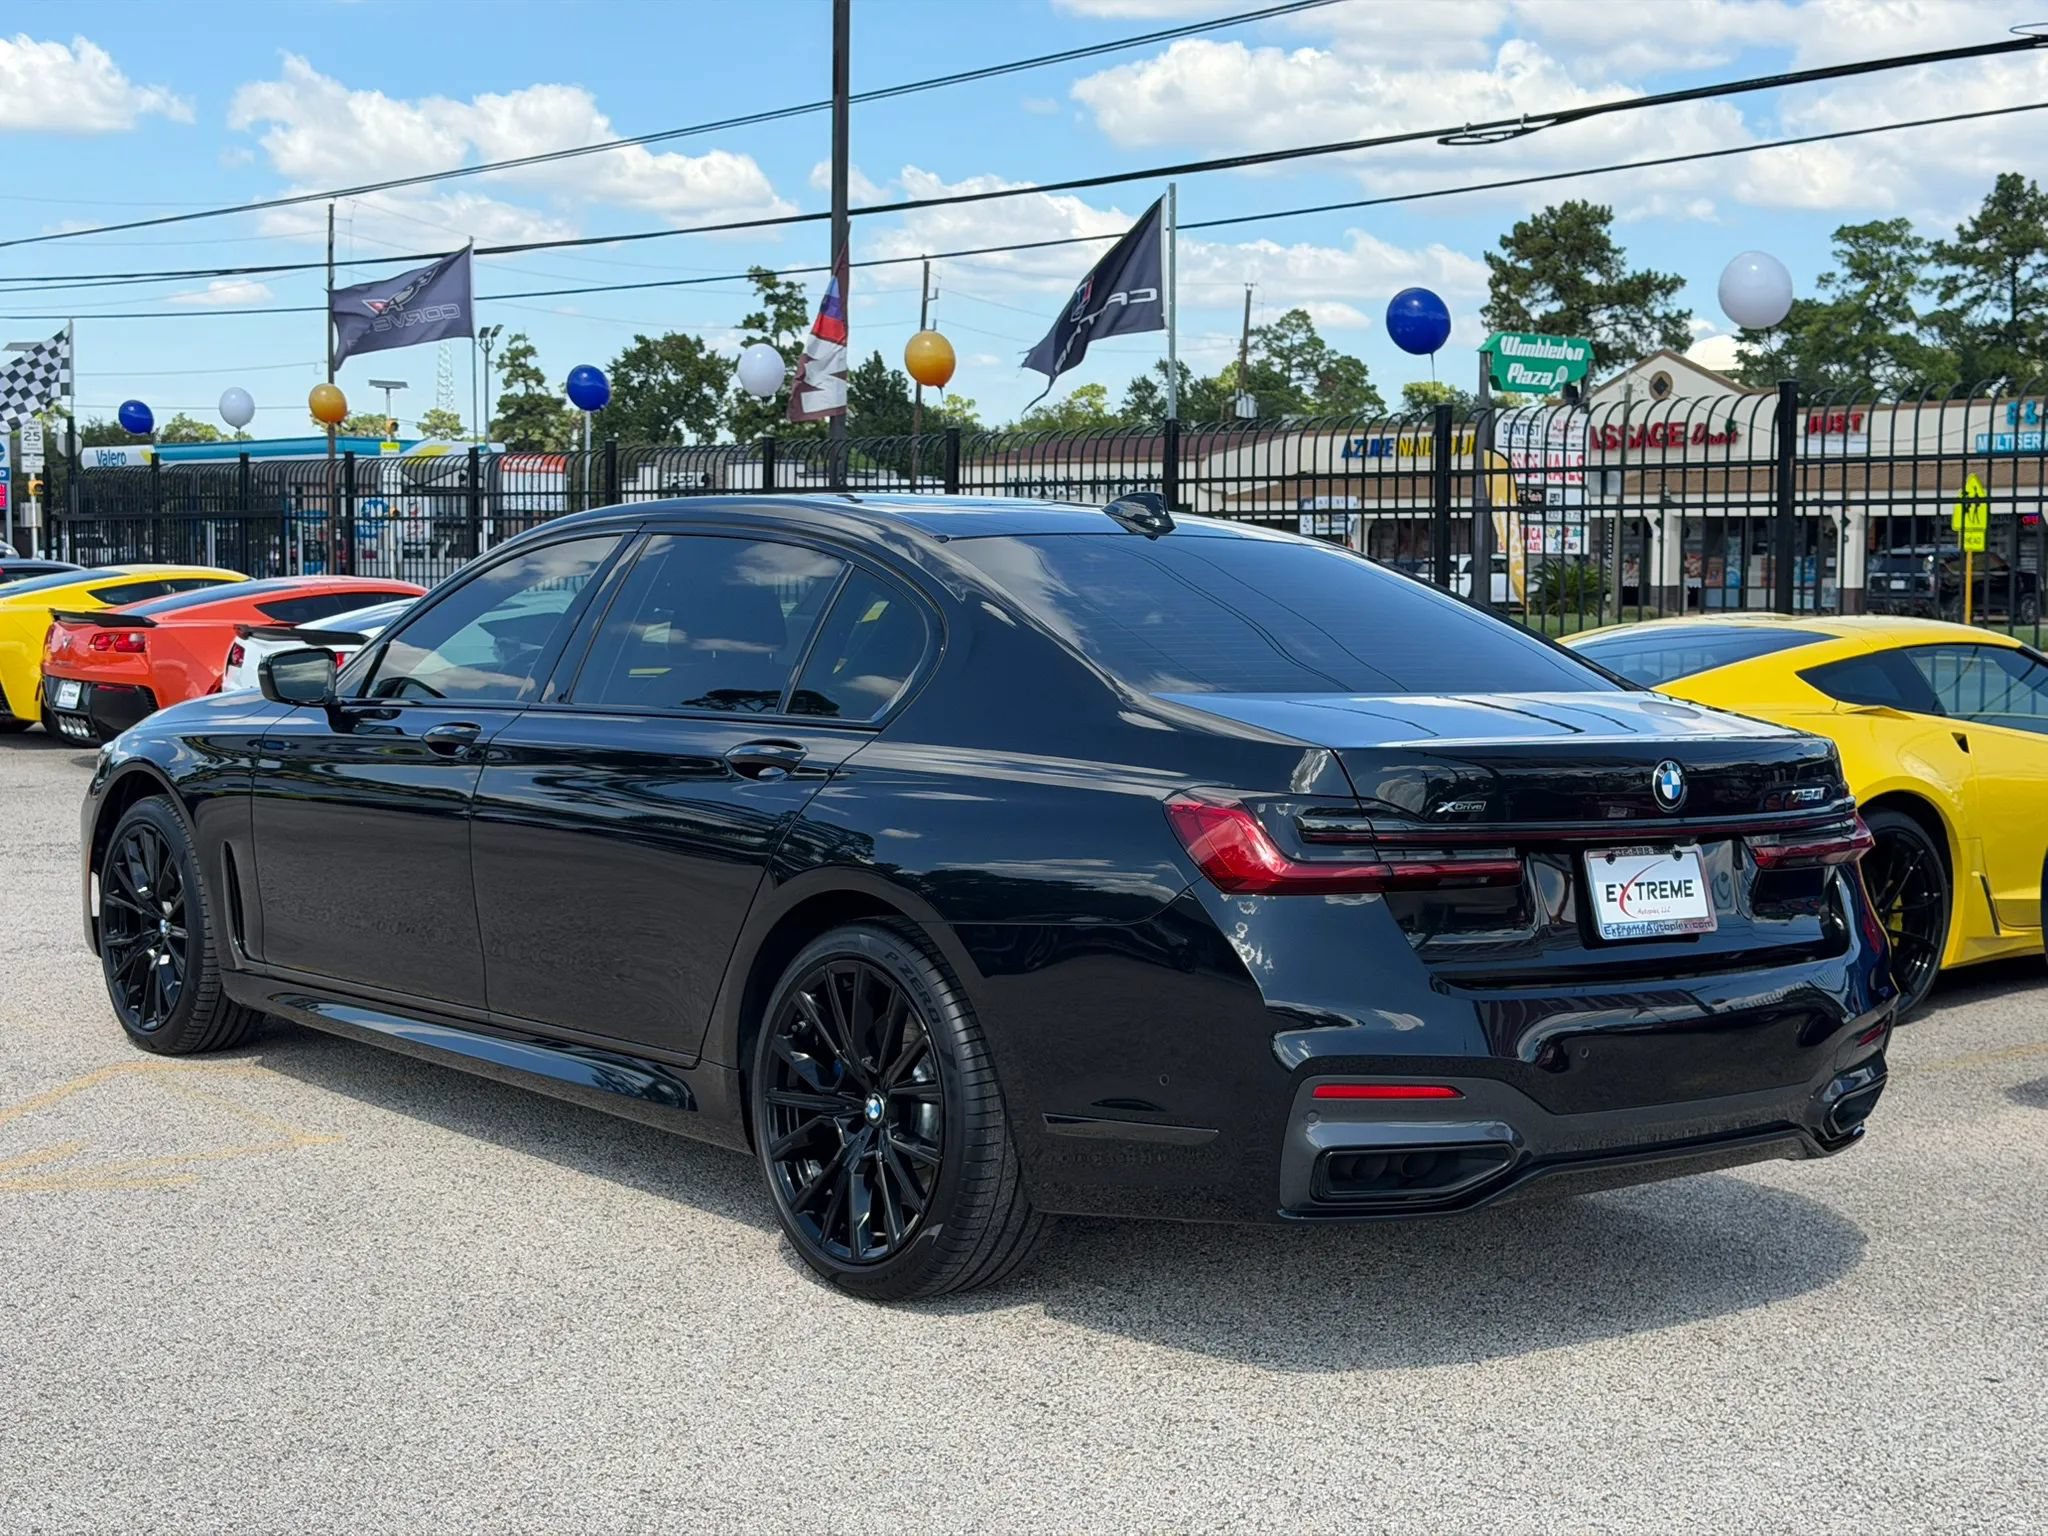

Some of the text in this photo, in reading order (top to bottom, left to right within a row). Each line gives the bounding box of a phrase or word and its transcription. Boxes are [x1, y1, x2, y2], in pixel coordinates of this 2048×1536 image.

[1501, 335, 1585, 361] Wimbledon
[1507, 362, 1554, 385] Plaza
[24, 432, 41, 441] 25
[1503, 422, 1540, 437] DNTST
[1589, 422, 1686, 449] ASSAGE
[96, 449, 127, 465] Valero
[1605, 879, 1695, 903] EXTREME
